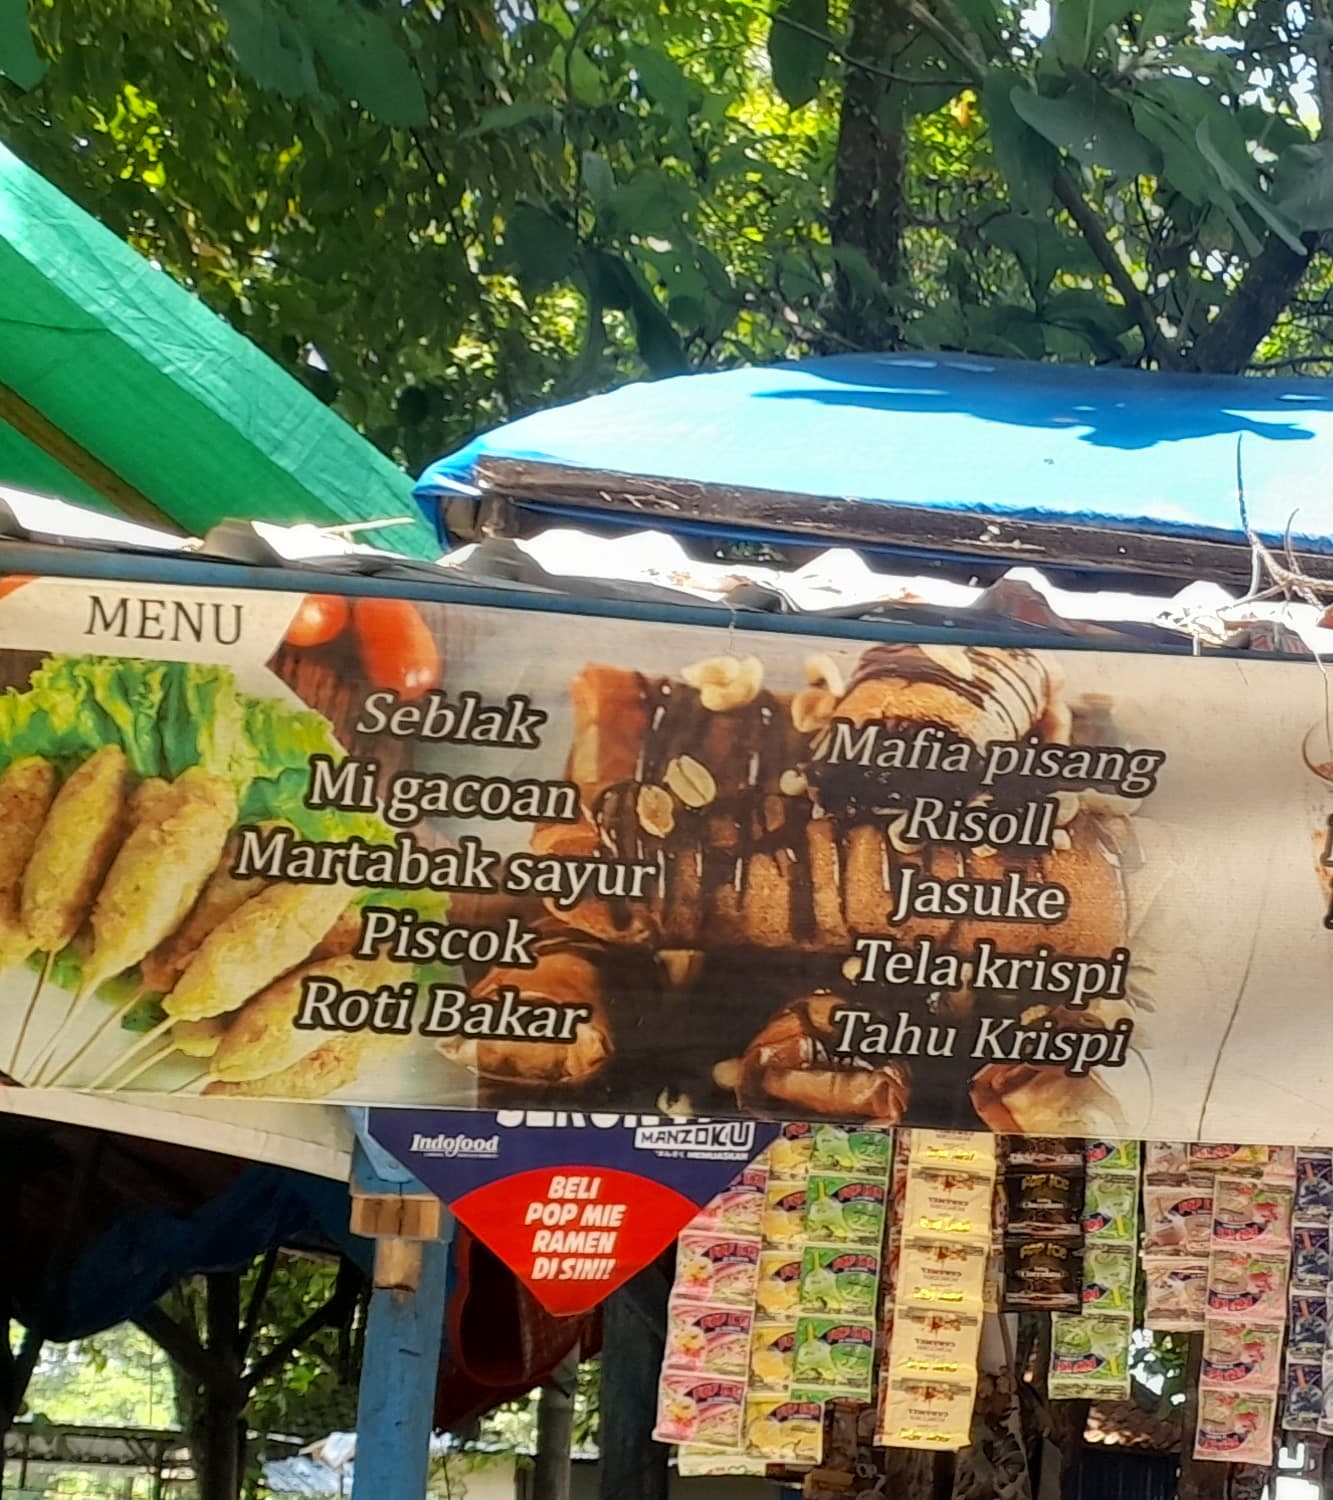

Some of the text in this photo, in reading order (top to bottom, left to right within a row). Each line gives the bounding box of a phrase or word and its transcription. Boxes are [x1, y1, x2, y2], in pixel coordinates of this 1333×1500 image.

[84, 595, 244, 645] MENU
[356, 692, 549, 746] Seblak
[828, 723, 1164, 793] Mafia pisang
[308, 760, 579, 824] Mi gacoan
[904, 798, 1057, 847] Risoll
[234, 830, 657, 903] Martabak sayur
[892, 868, 1067, 921] Jasuke
[357, 912, 538, 965] Piscok
[855, 939, 1129, 1006] Tela krispi
[299, 981, 589, 1041] Roti Bakar
[832, 1009, 1132, 1074] Tahu Krispi
[410, 1133, 500, 1157] Indofood
[640, 1122, 752, 1148] MANZOKU
[547, 1175, 601, 1200] BELI
[524, 1202, 628, 1228] POP MIE
[530, 1229, 617, 1254] RAMEN
[530, 1257, 618, 1281] DI SINI!
